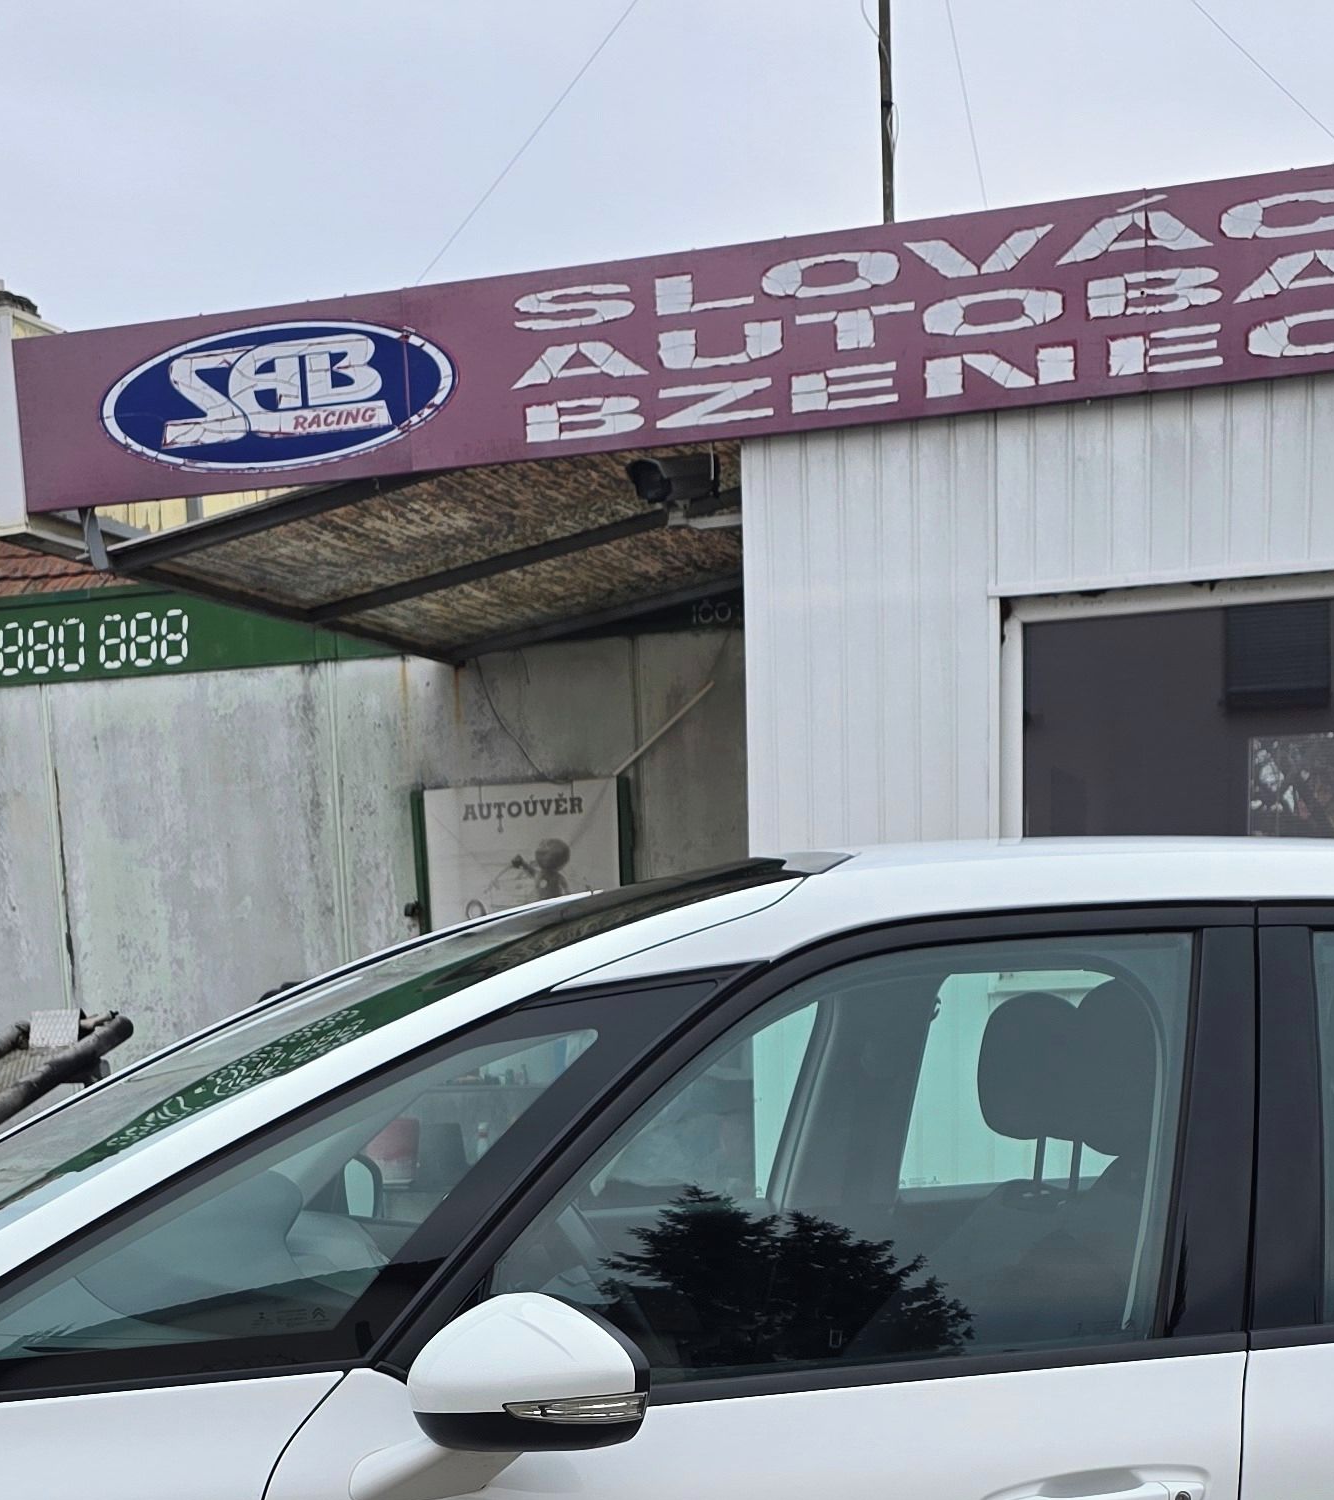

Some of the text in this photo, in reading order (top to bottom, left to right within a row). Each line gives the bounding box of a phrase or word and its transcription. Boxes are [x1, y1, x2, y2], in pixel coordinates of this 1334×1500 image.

[162, 333, 383, 450] SAB
[293, 408, 378, 431] RACING
[99, 608, 189, 670] 888
[462, 791, 584, 822] AUTOÚVĚR
